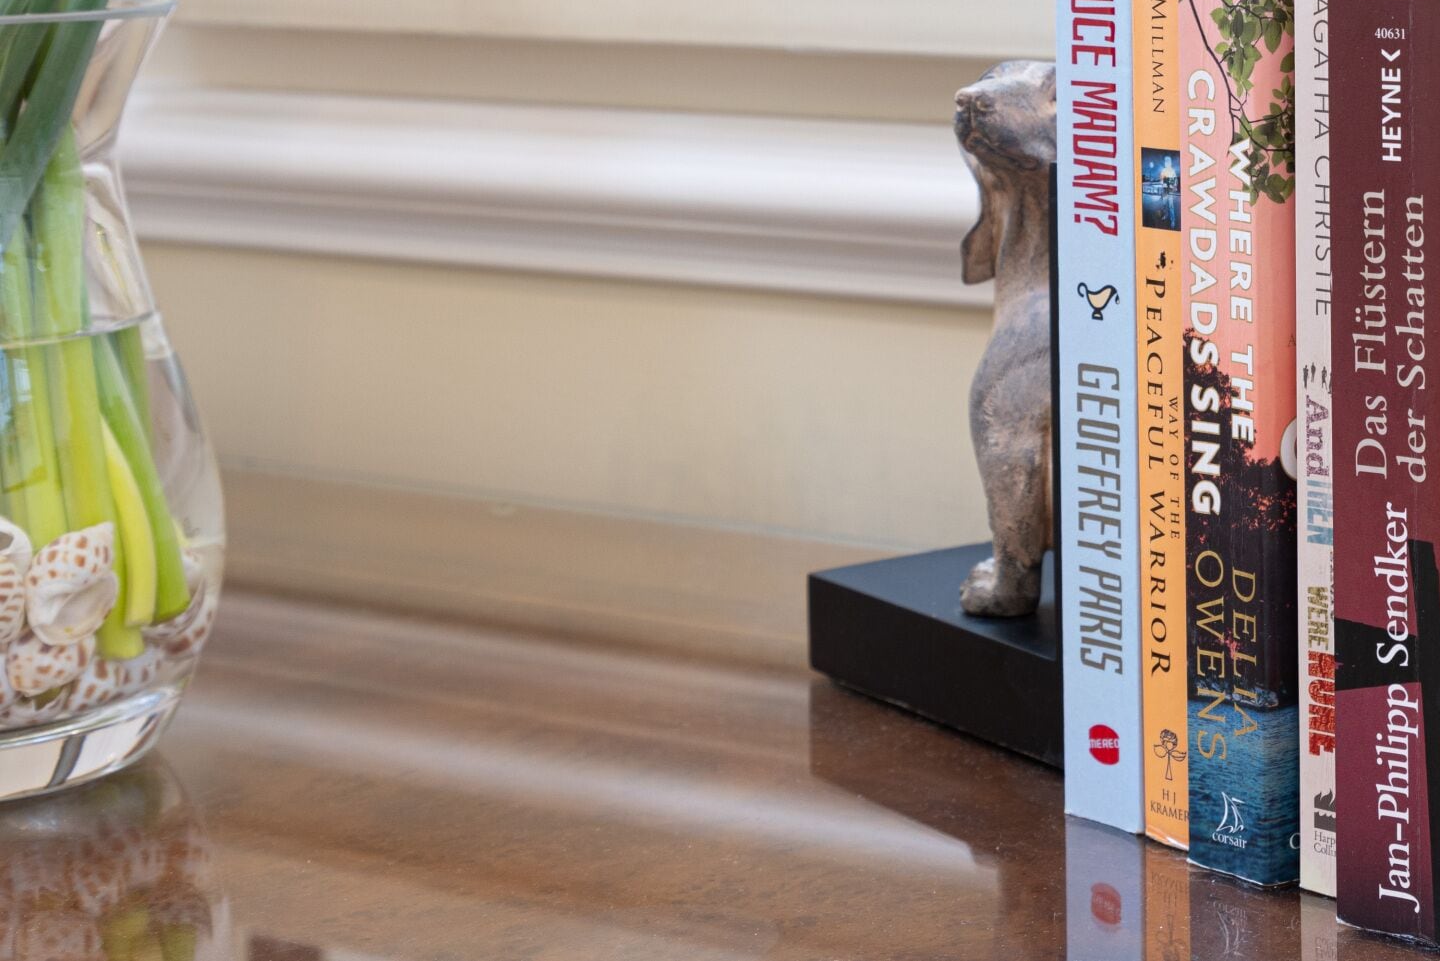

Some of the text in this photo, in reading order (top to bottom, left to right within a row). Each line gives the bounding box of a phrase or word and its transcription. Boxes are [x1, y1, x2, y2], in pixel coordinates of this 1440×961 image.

[1375, 28, 1406, 40] 40631
[1071, 80, 1119, 236] MADAM?
[1381, 67, 1402, 162] HEYNE
[1187, 69, 1222, 516] CRAWDADS SING
[1228, 138, 1254, 443] WHERE THE
[1352, 188, 1388, 480] Das Flüstern
[1395, 194, 1426, 483] der Schatten
[1145, 275, 1170, 677] PEACEFUL WARRIOR
[1169, 396, 1181, 539] WAY OF THE
[1306, 394, 1329, 478] And
[1076, 363, 1124, 675] GEOFFREY PARIS
[1195, 550, 1228, 761] OWENS
[1232, 566, 1258, 737] DELIA
[1307, 586, 1329, 650] WERE
[1307, 650, 1336, 756] NONE
[1373, 502, 1420, 913] Jan-Philipp Sendker
[1150, 800, 1189, 822] KRAMER
[1212, 831, 1247, 849] corsair
[1314, 830, 1336, 848] Harp
[1314, 842, 1336, 858] Colli
